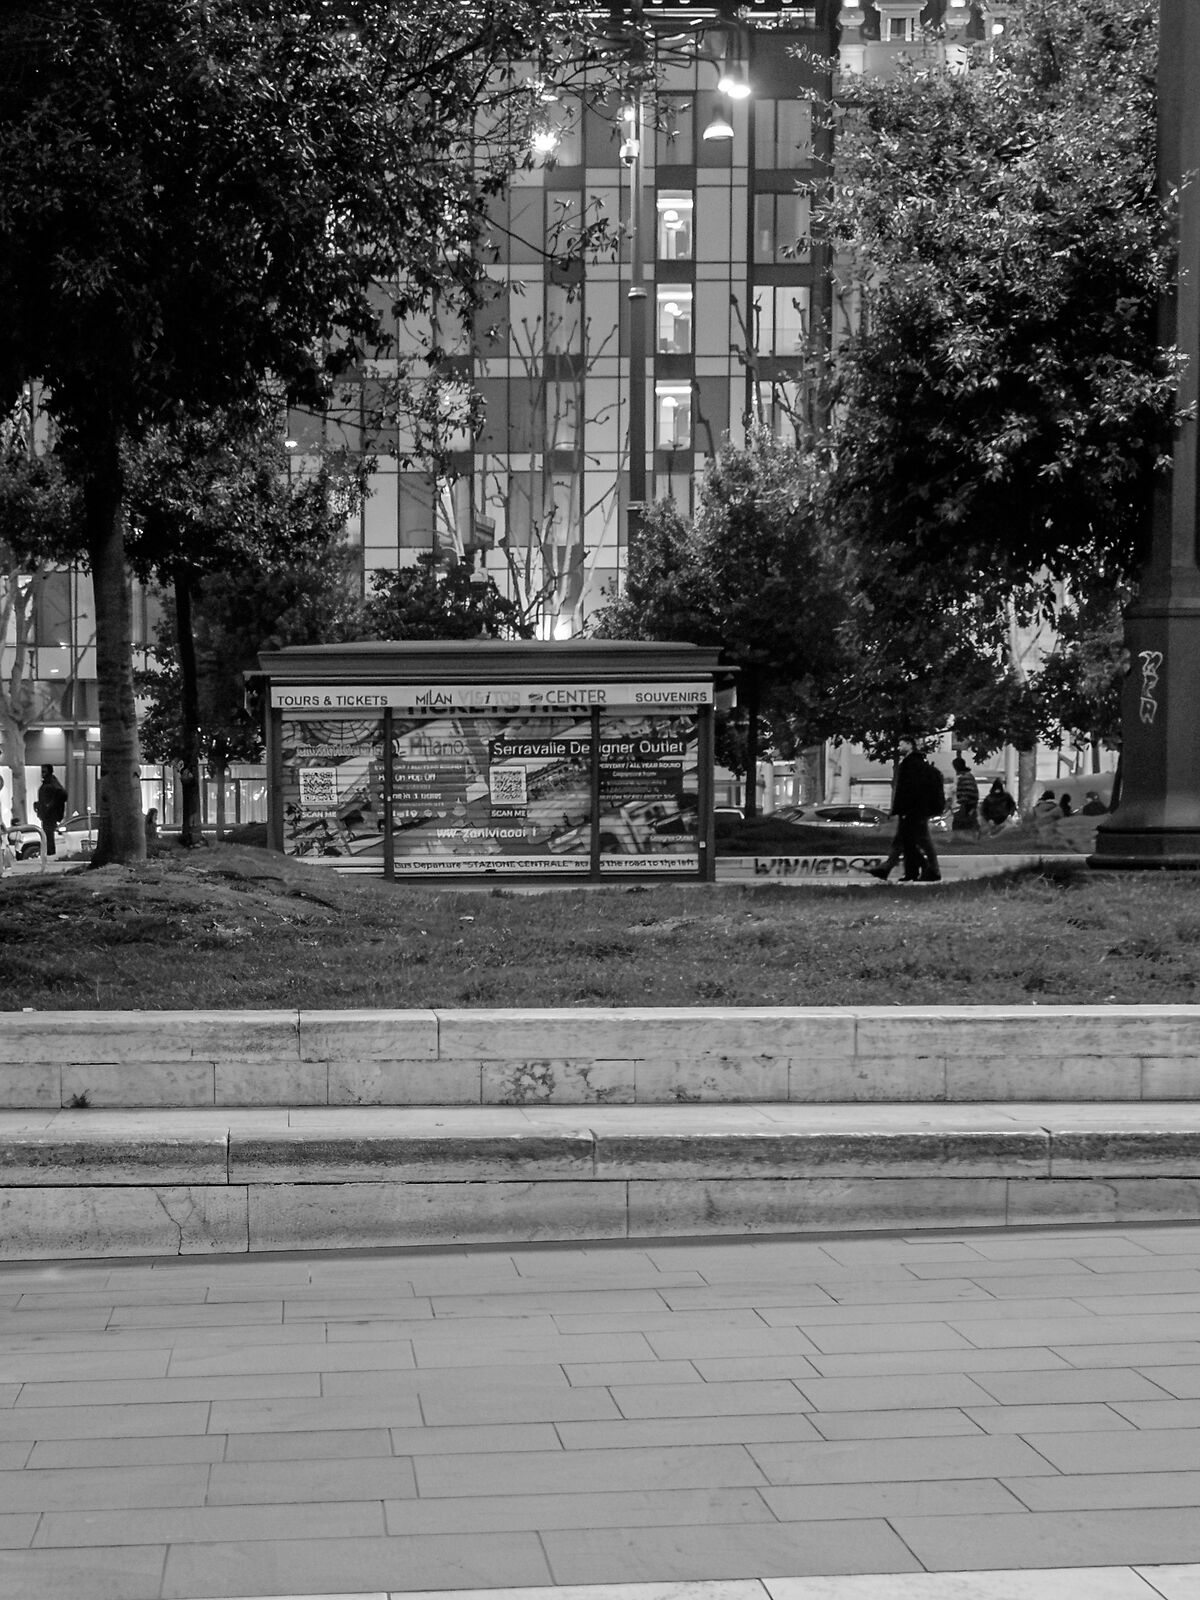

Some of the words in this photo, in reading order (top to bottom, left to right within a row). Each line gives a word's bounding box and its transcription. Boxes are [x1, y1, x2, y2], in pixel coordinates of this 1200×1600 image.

[277, 695, 320, 706] TOURS
[323, 695, 332, 706] &
[336, 695, 388, 706] TICKETS
[416, 689, 452, 705] MILAN
[546, 689, 607, 704] CENTER
[635, 692, 708, 703] SOUVENIRS
[493, 741, 566, 755] Serravalle
[570, 740, 635, 757] Deigner
[639, 740, 684, 754] Outlet
